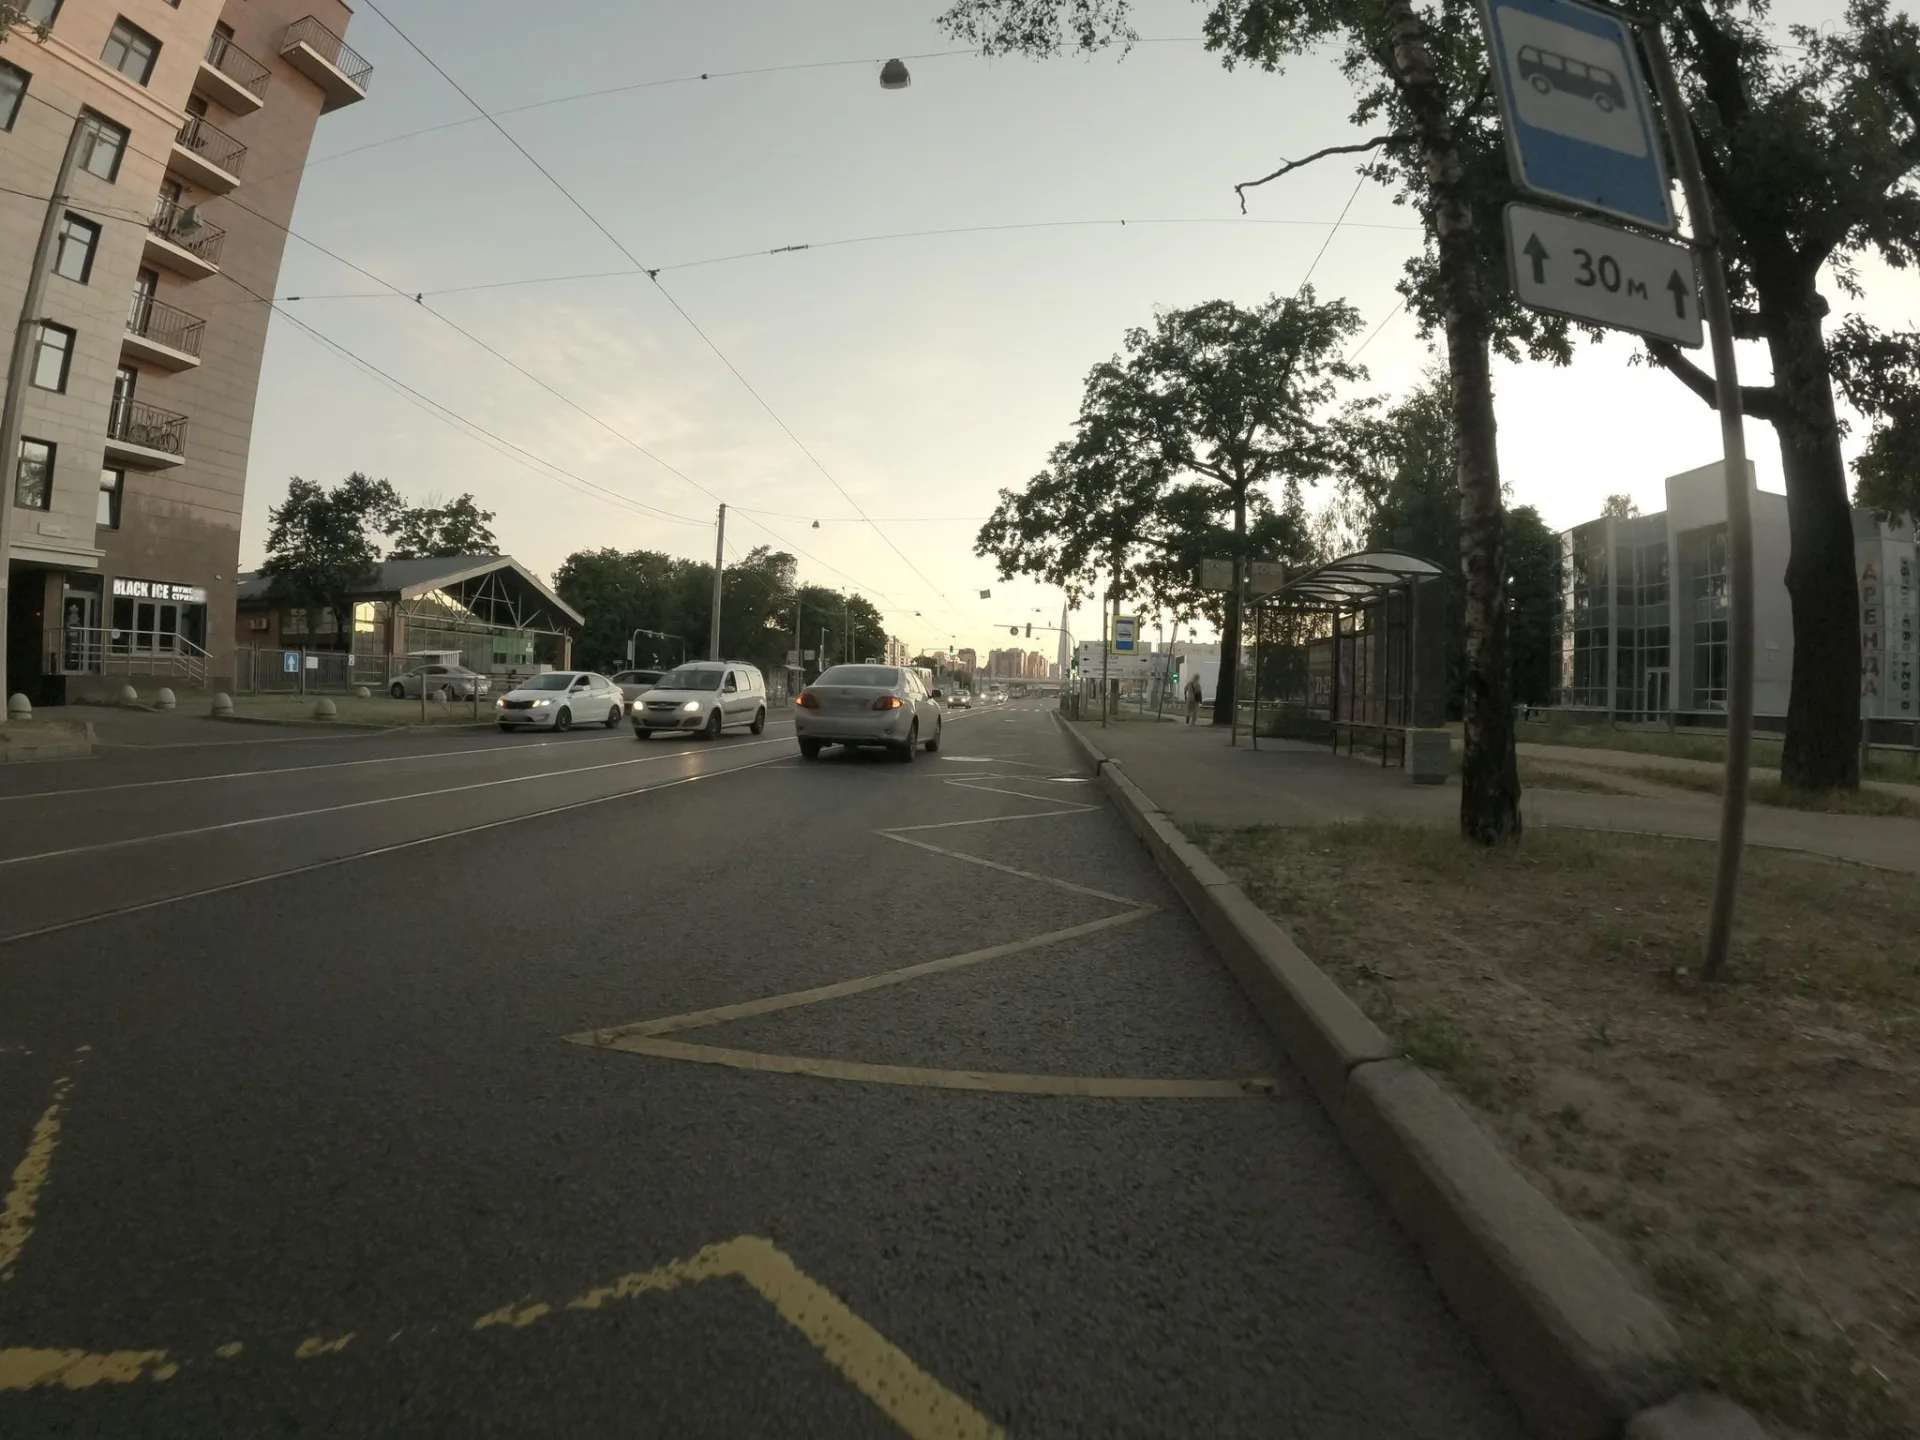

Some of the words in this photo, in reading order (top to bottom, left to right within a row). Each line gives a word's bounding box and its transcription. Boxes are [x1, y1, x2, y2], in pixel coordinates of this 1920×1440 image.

[113, 580, 148, 597] BLACK
[151, 583, 169, 599] ICE
[1861, 563, 1879, 697] АРЕНДА
